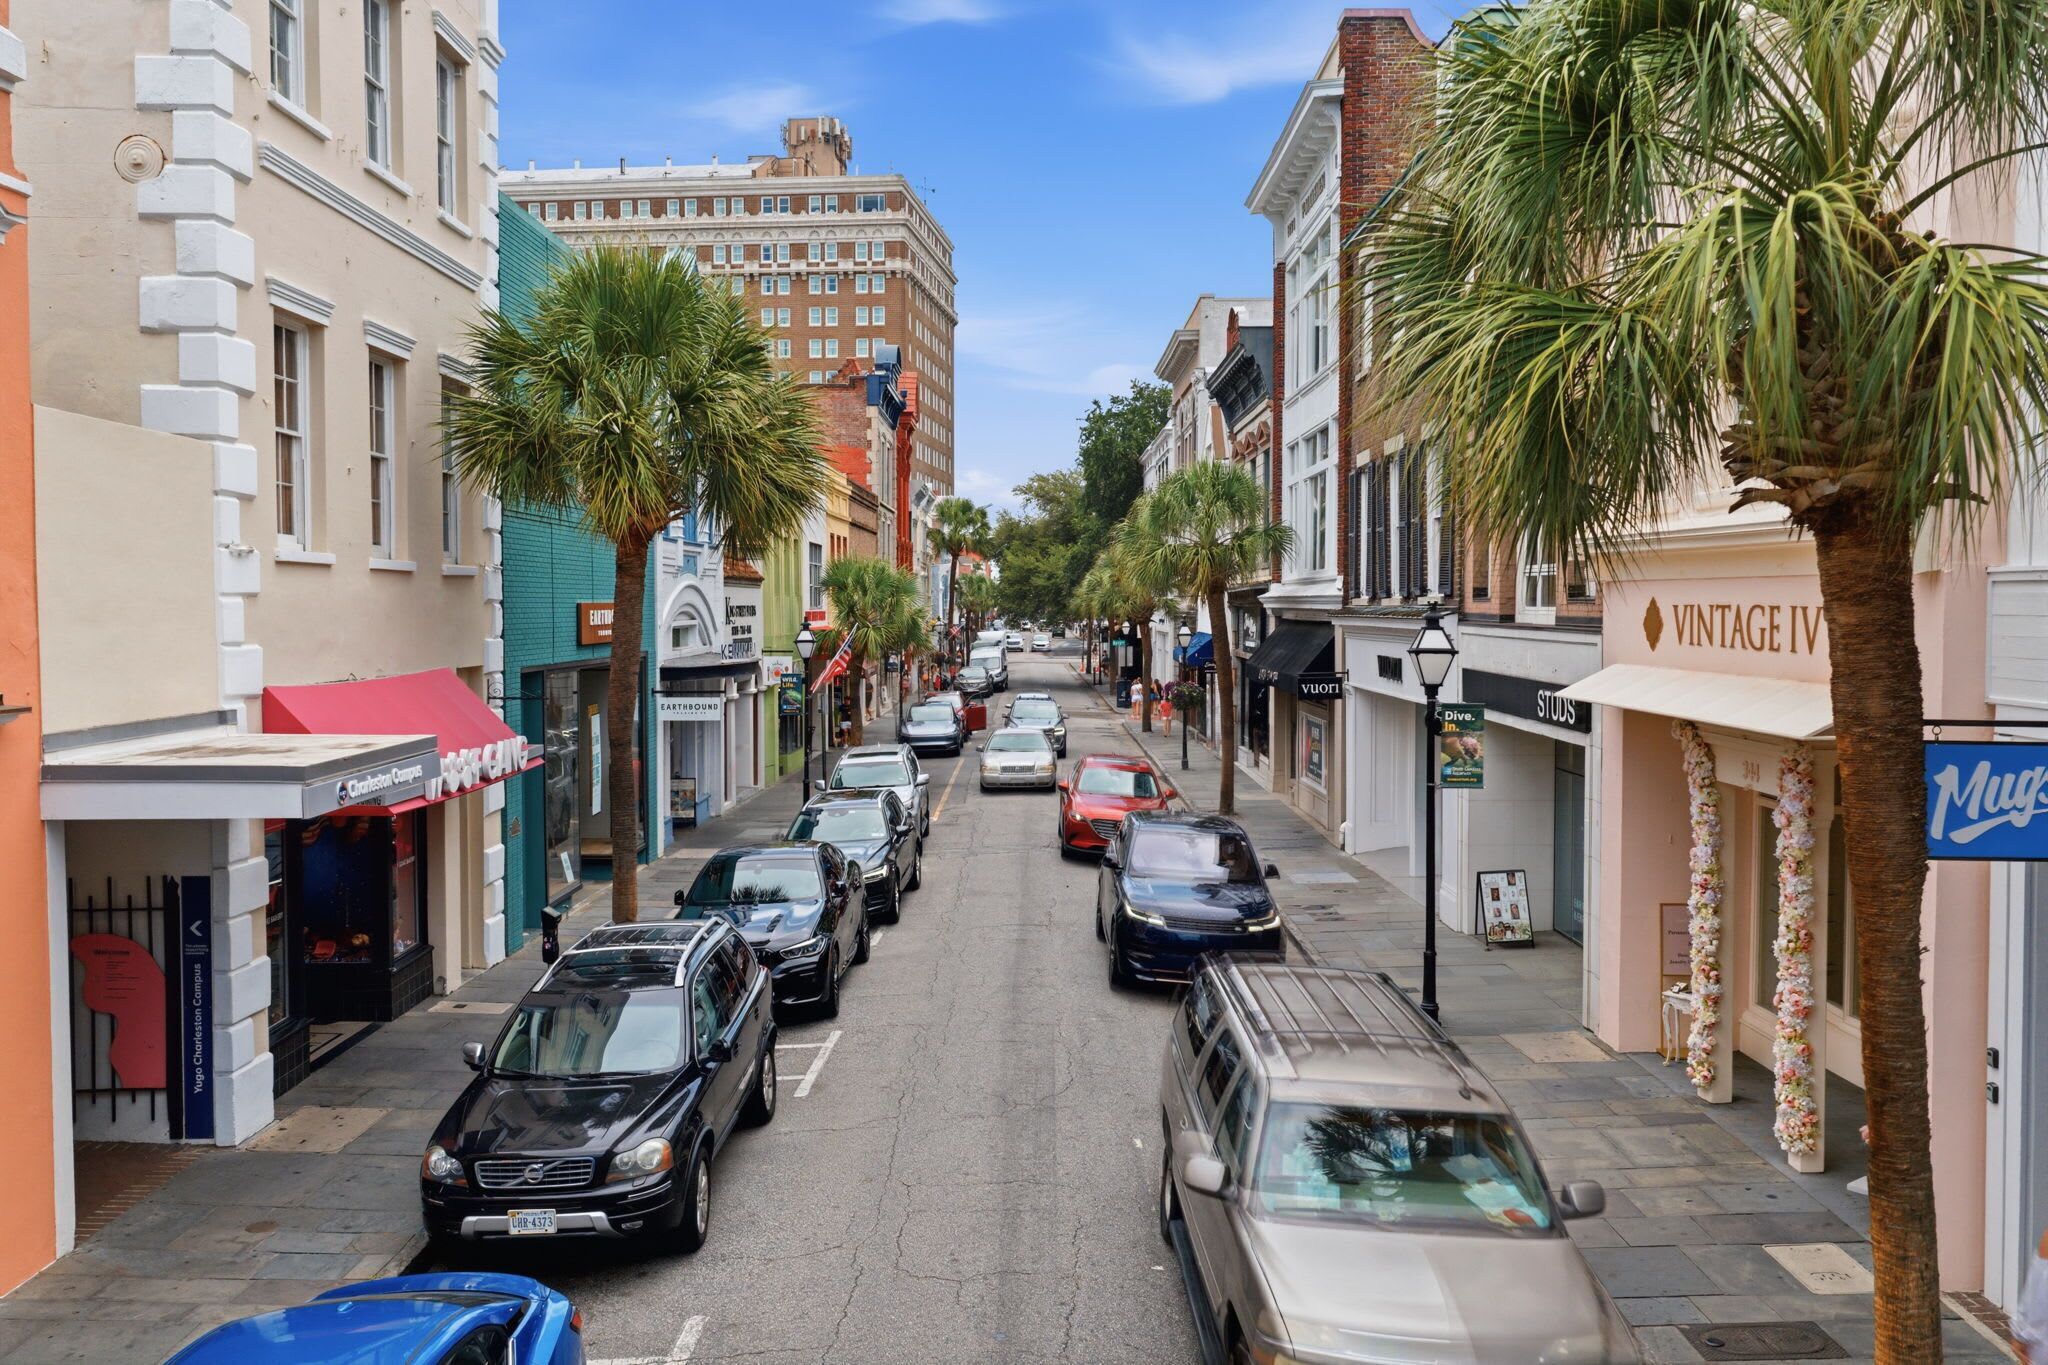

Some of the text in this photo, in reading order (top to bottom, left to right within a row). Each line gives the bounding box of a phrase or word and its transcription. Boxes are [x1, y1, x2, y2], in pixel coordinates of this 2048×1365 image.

[1672, 604, 1781, 653] VINTAGE
[660, 703, 719, 711] EARTHBOUND
[1444, 710, 1476, 721] Dive.
[1537, 689, 1575, 725] STUDS
[1444, 721, 1460, 731] In.
[347, 763, 423, 800] Charleston Campus
[193, 963, 205, 1094] Yugo Charleston Campus
